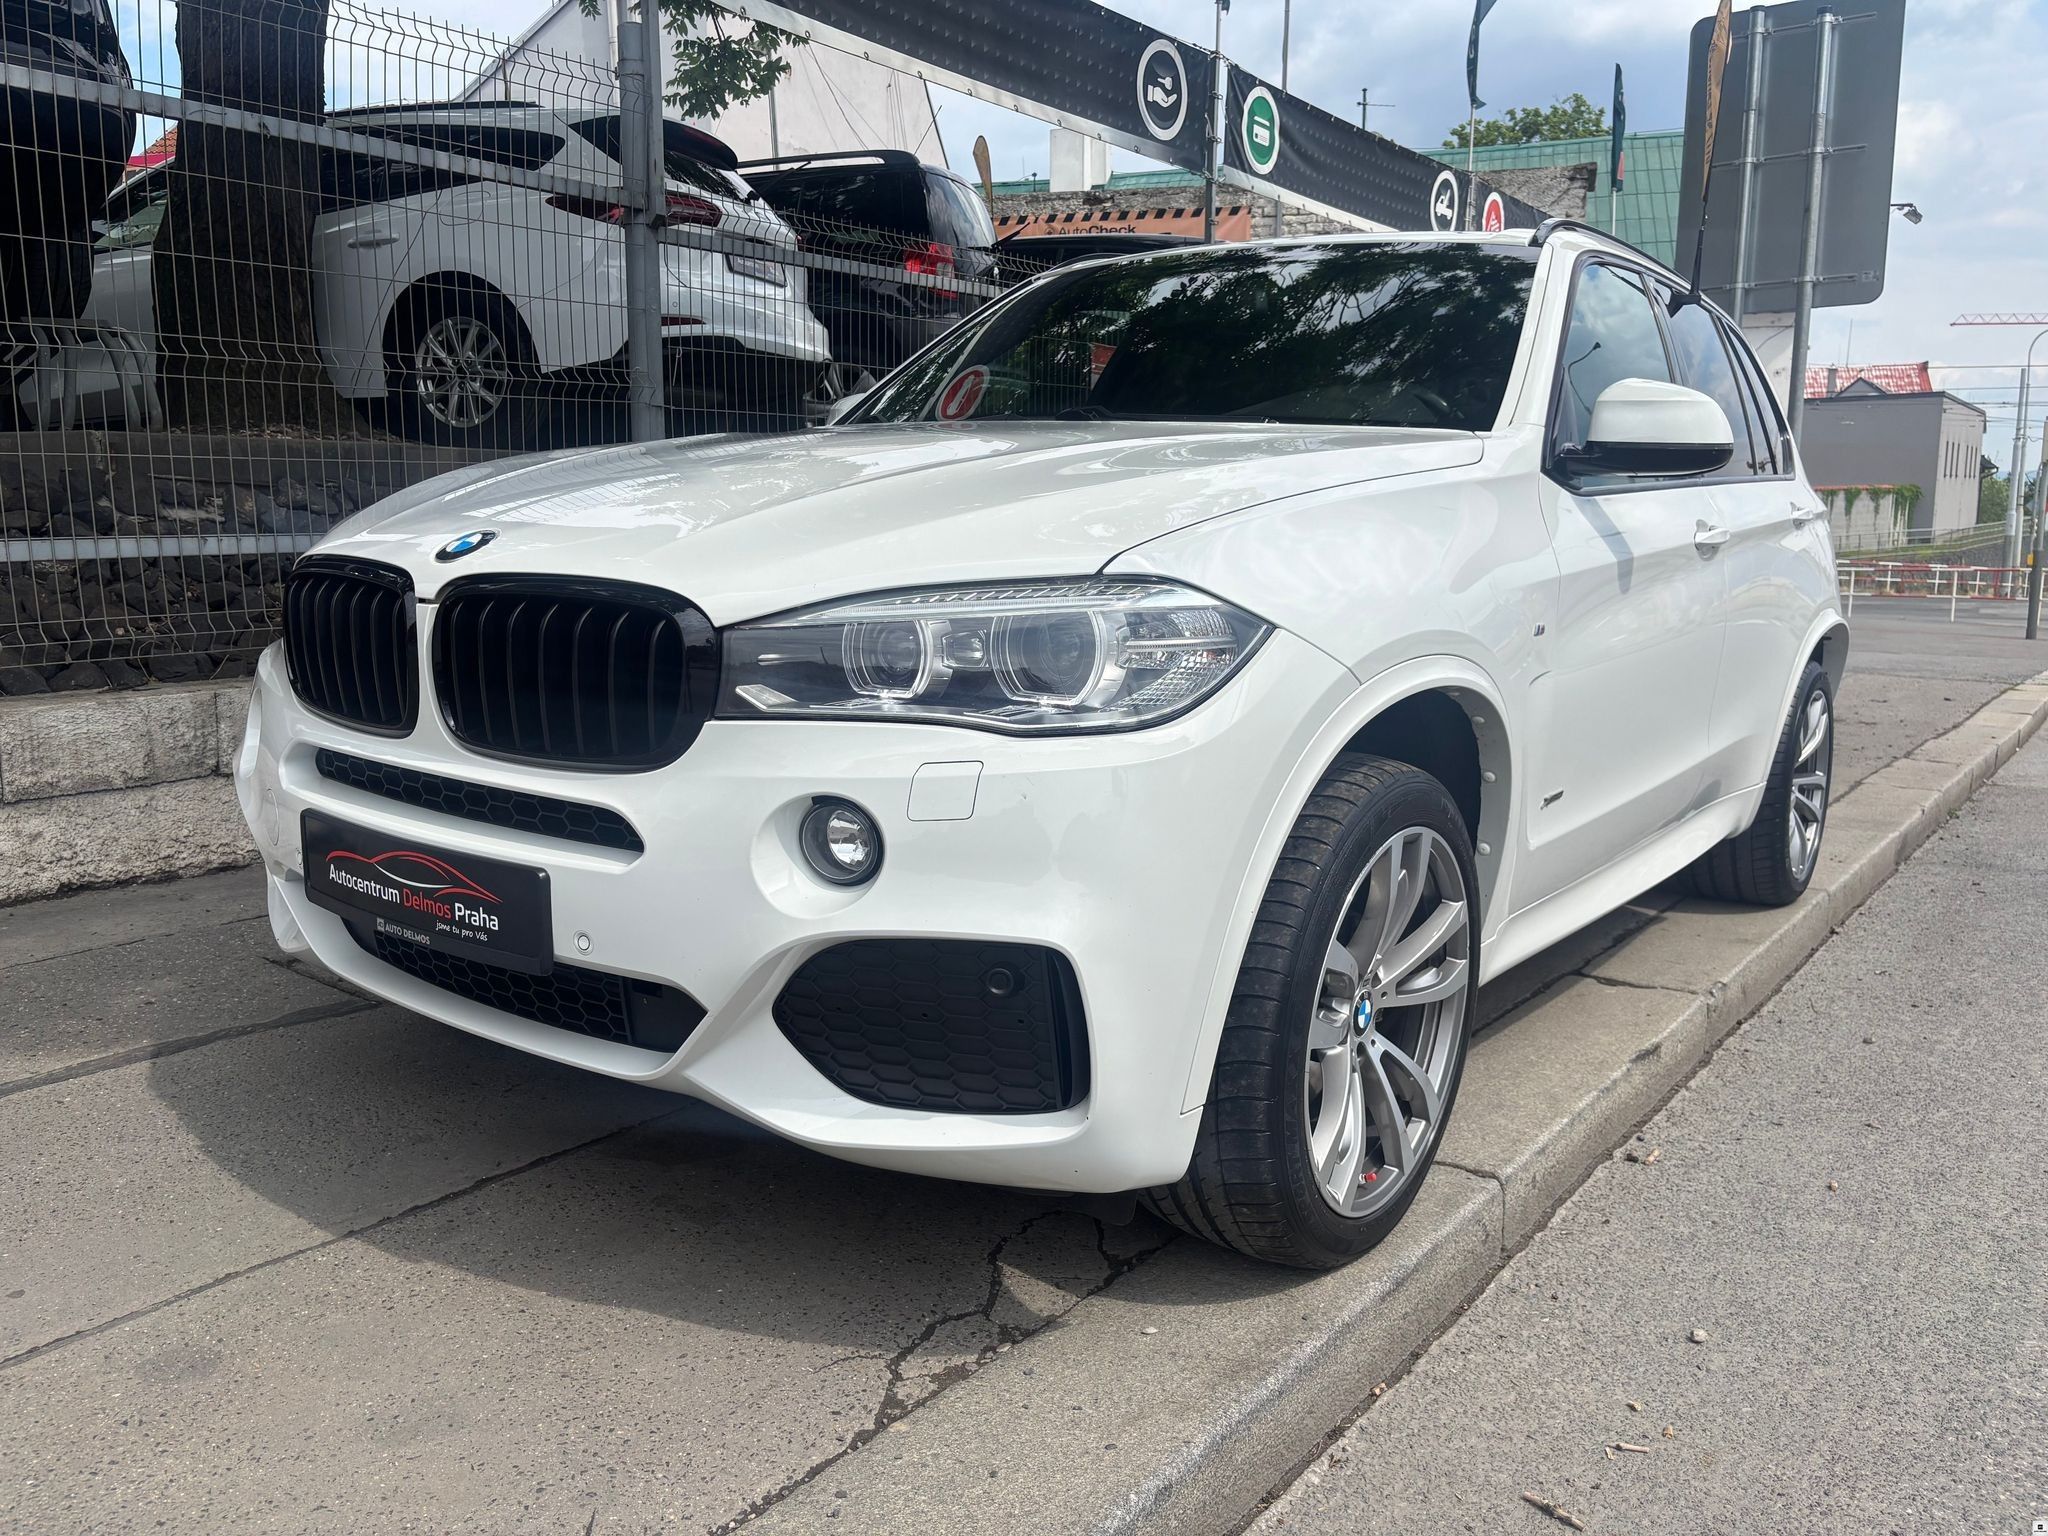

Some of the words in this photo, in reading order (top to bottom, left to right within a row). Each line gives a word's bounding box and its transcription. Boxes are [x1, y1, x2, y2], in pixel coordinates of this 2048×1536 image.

[329, 863, 400, 904] Autocentrum
[403, 888, 451, 919] Delmos
[454, 902, 499, 931] Praha
[385, 922, 402, 936] AUTO
[403, 929, 431, 945] DELMOS
[435, 919, 451, 931] jsme
[452, 926, 460, 935] tu
[461, 928, 474, 938] pro
[475, 931, 488, 942] Vás
